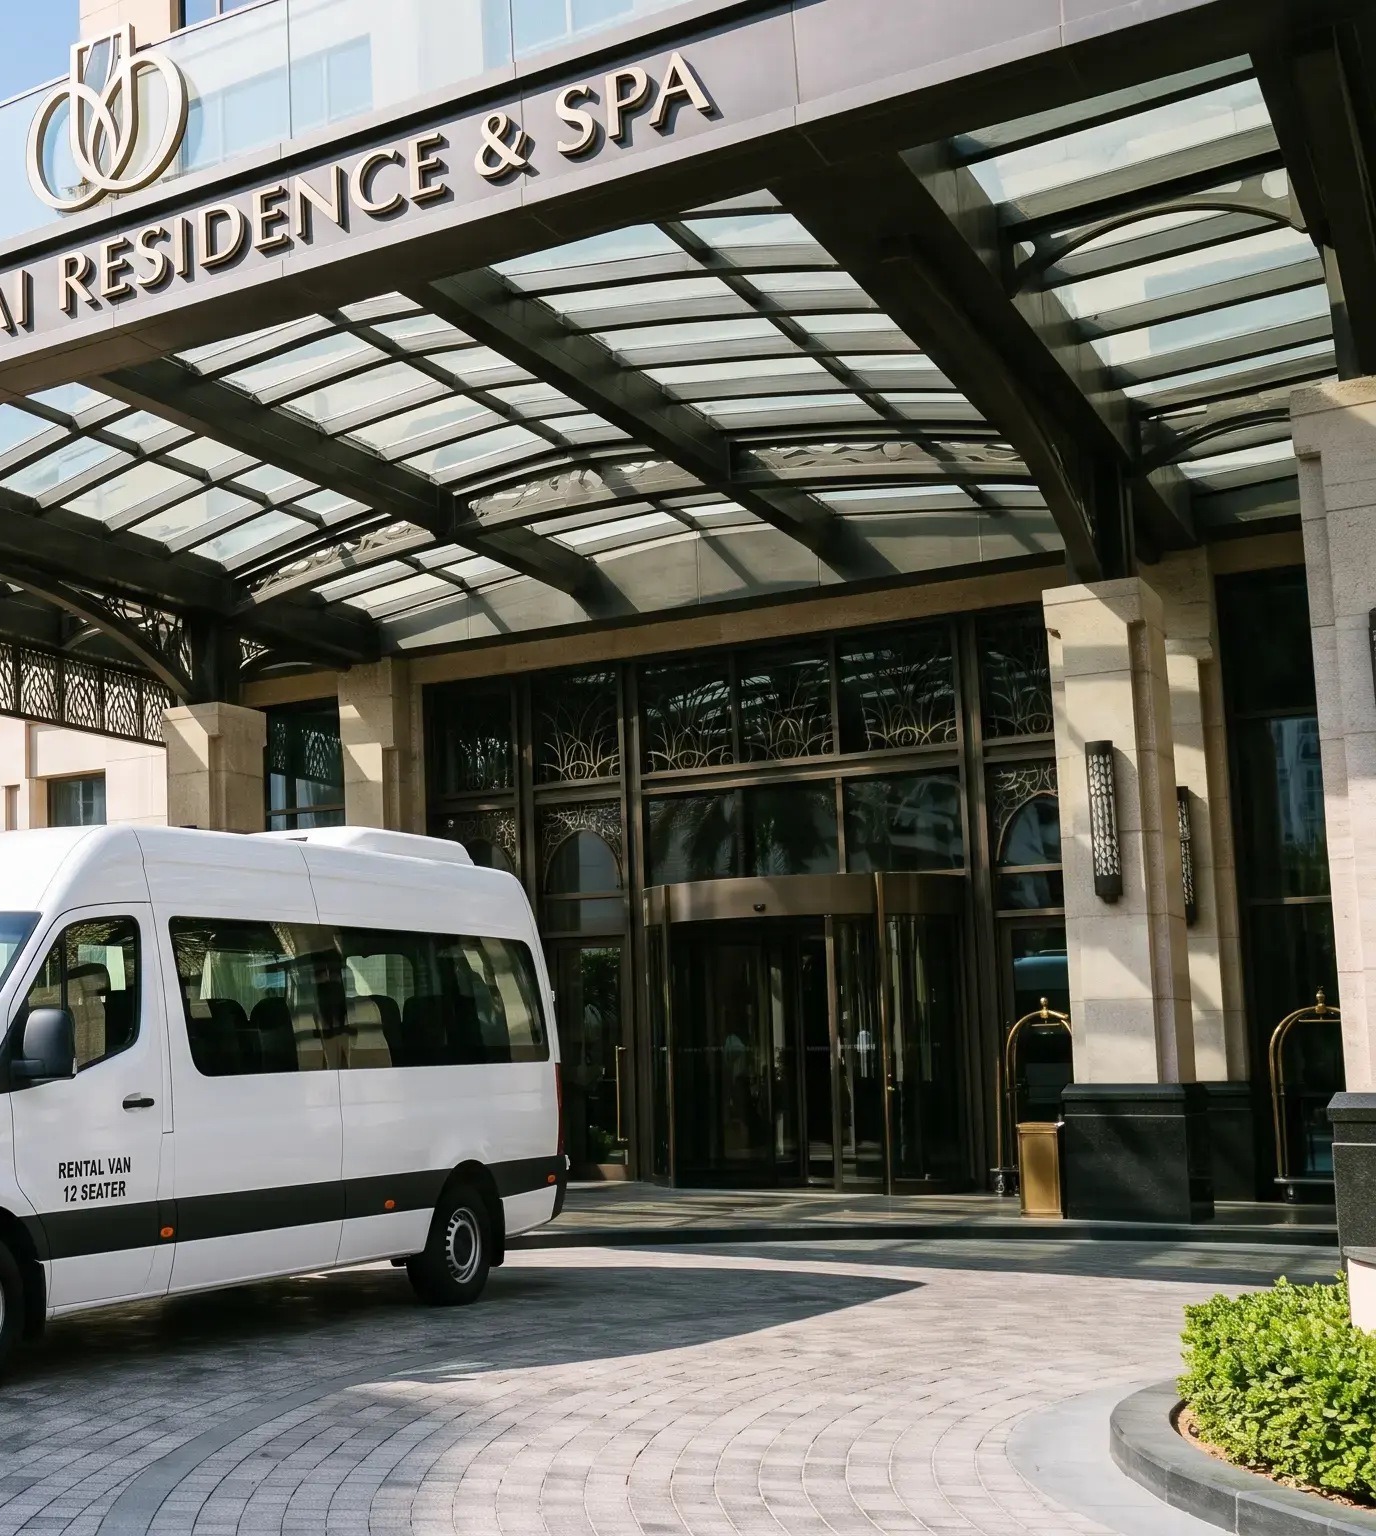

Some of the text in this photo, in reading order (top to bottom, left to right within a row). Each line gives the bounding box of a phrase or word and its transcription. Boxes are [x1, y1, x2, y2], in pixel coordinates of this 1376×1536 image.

[58, 132, 449, 314] RESIDENCE
[474, 111, 530, 180] &
[555, 51, 714, 156] SPA
[58, 1156, 131, 1179] RENTAL VAN
[63, 1180, 126, 1203] 12 SEATER
